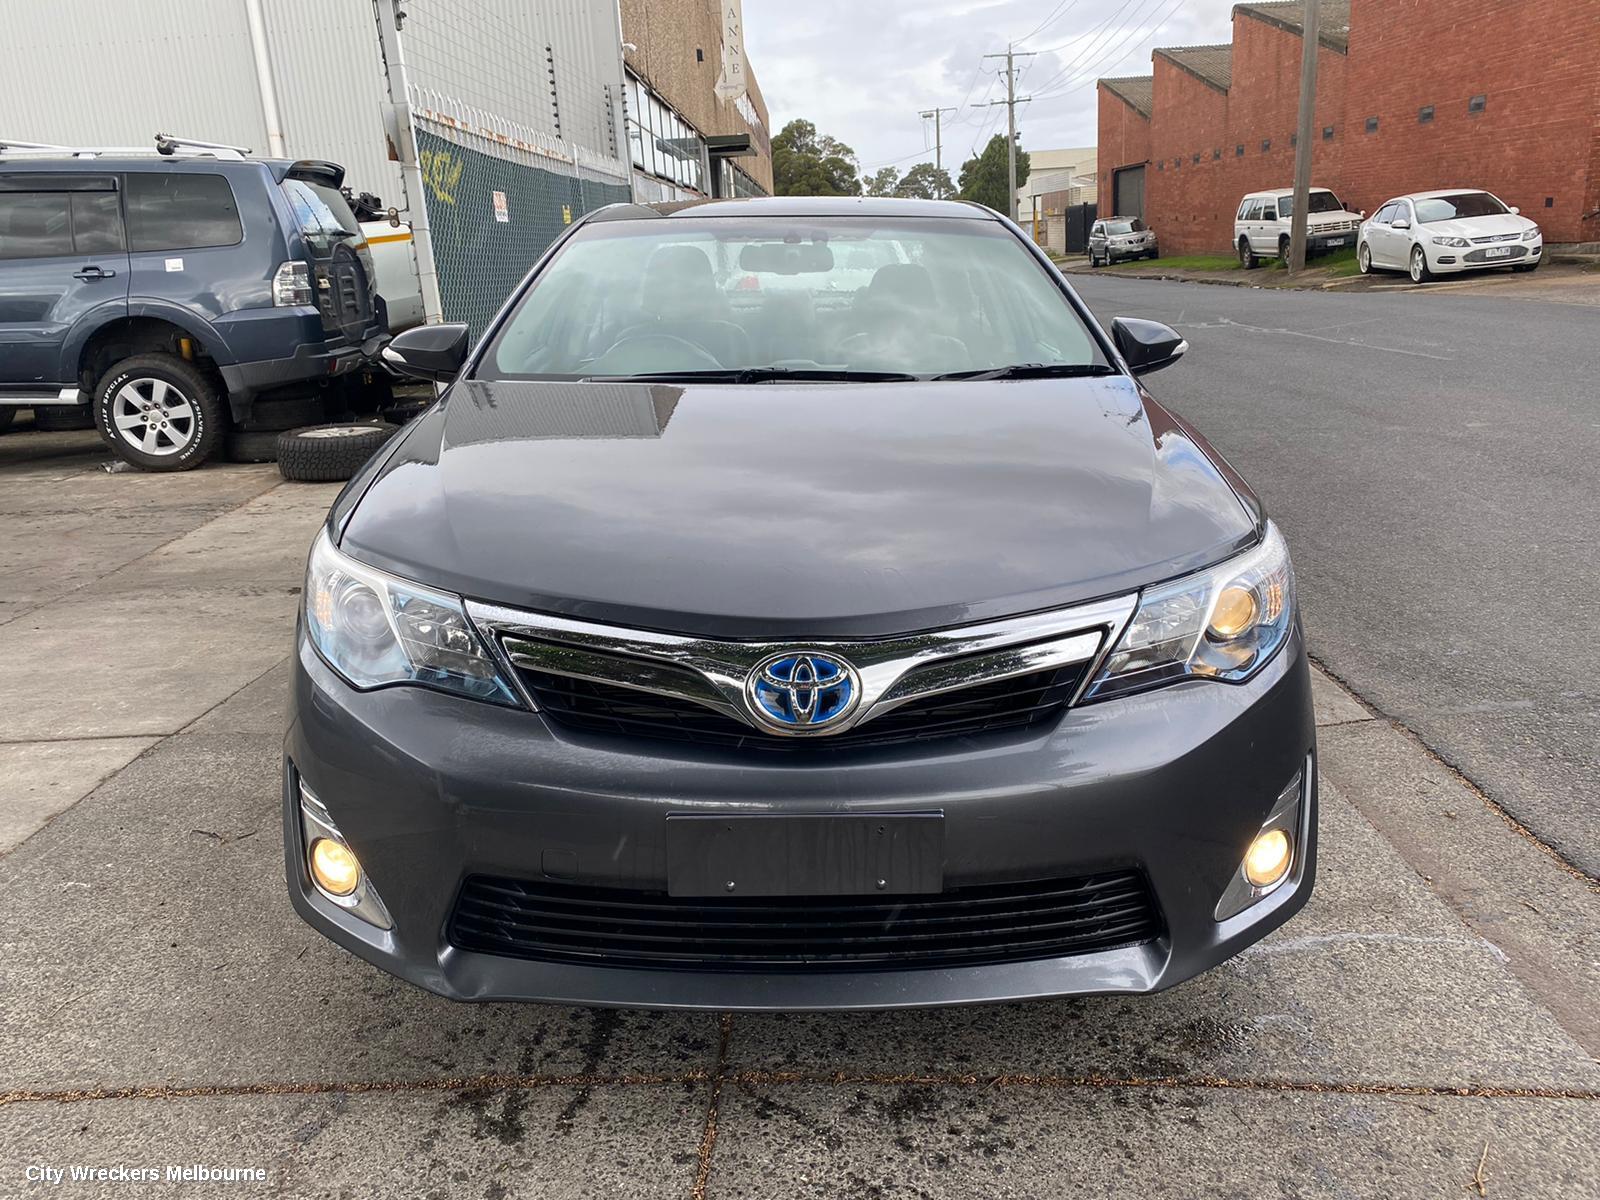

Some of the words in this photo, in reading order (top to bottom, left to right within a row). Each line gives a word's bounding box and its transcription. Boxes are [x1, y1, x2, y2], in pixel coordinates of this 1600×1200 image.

[103, 373, 128, 404] SPECIAL
[102, 408, 116, 439] AT-117
[180, 404, 204, 460] SILVERSTONE
